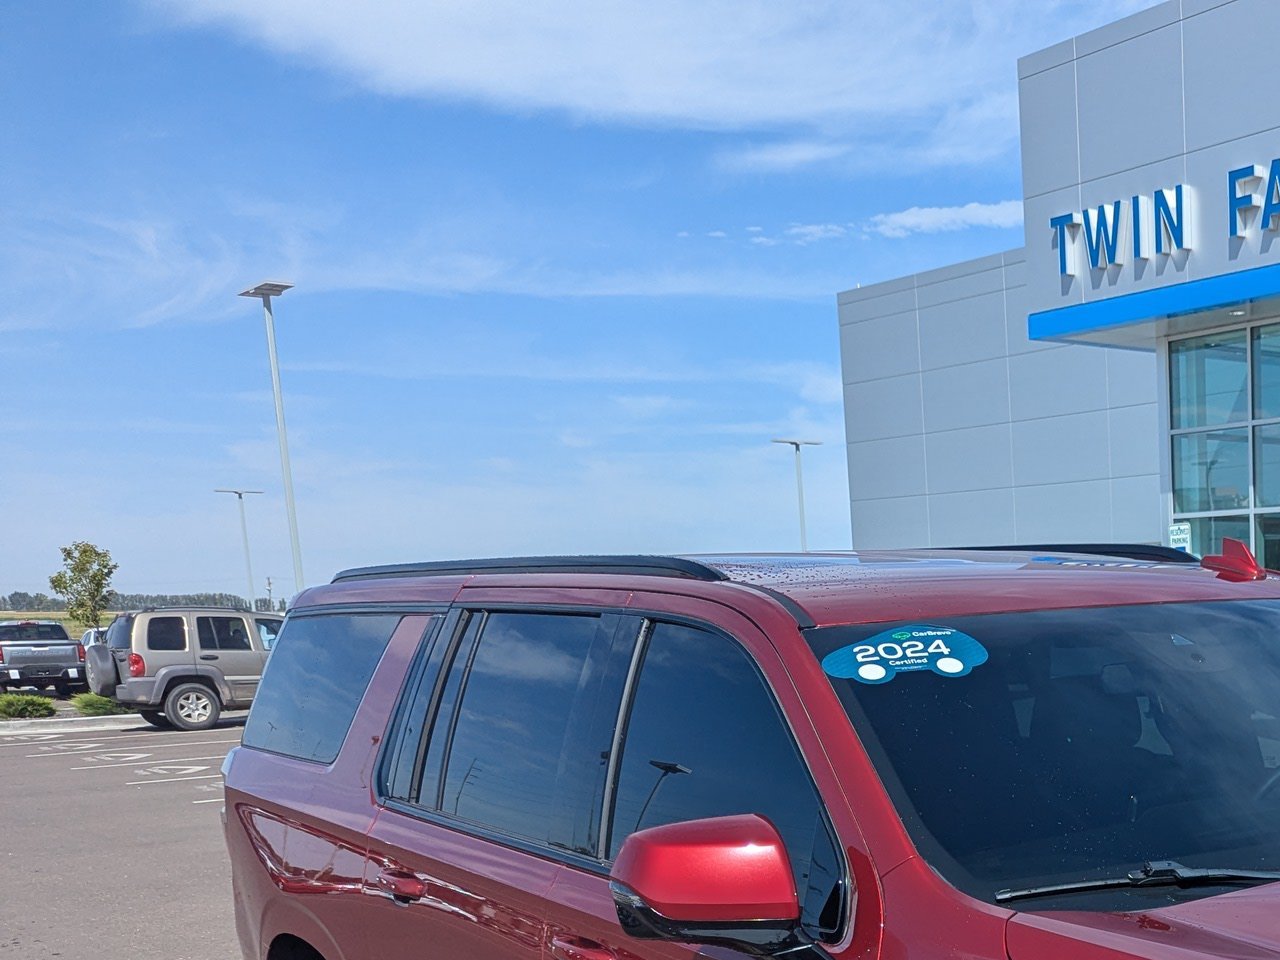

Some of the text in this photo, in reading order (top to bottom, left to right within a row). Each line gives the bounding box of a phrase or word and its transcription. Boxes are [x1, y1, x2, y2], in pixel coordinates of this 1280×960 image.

[1050, 184, 1189, 276] TWIN
[853, 639, 951, 662] 2024
[889, 658, 928, 666] Certified
